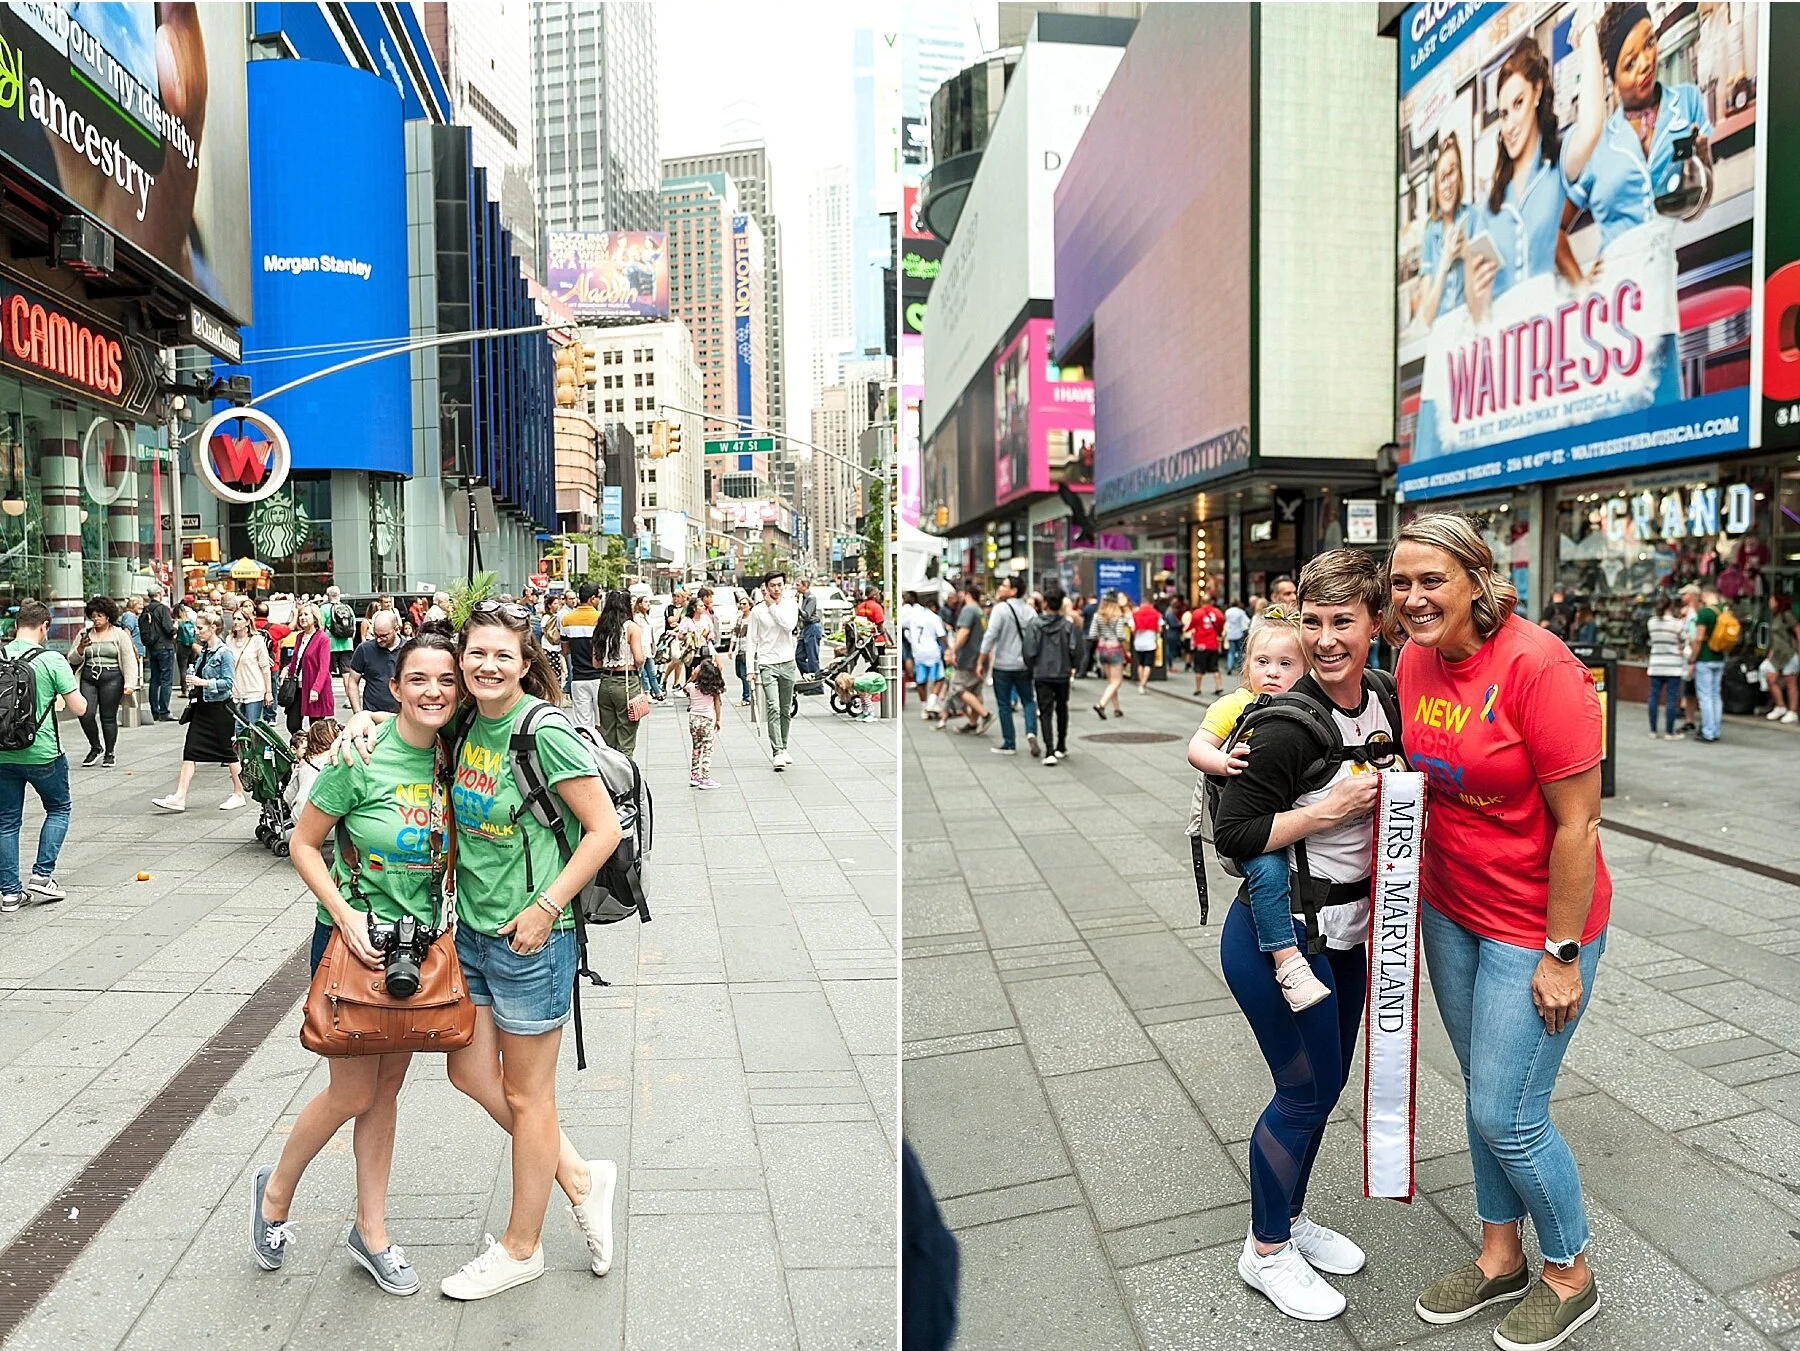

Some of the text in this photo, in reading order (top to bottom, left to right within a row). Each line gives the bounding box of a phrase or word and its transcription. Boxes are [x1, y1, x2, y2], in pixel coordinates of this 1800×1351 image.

[1410, 34, 1438, 72] LAST
[108, 55, 134, 110] my
[138, 76, 198, 170] identity.
[263, 254, 373, 281] Morgan Stanley
[735, 226, 751, 317] NOVOTEL
[10, 294, 123, 397] CAMINOS
[1447, 279, 1644, 424] WAITRESS
[719, 442, 730, 453] W
[732, 441, 745, 452] 47
[1606, 483, 1752, 542] GRAND
[1413, 694, 1472, 734] NEW
[462, 741, 503, 776] NEW
[1410, 752, 1465, 792] CITY
[455, 764, 498, 796] YORK
[451, 786, 494, 821] CITY
[1378, 799, 1416, 1034] MRS MARYLAND
